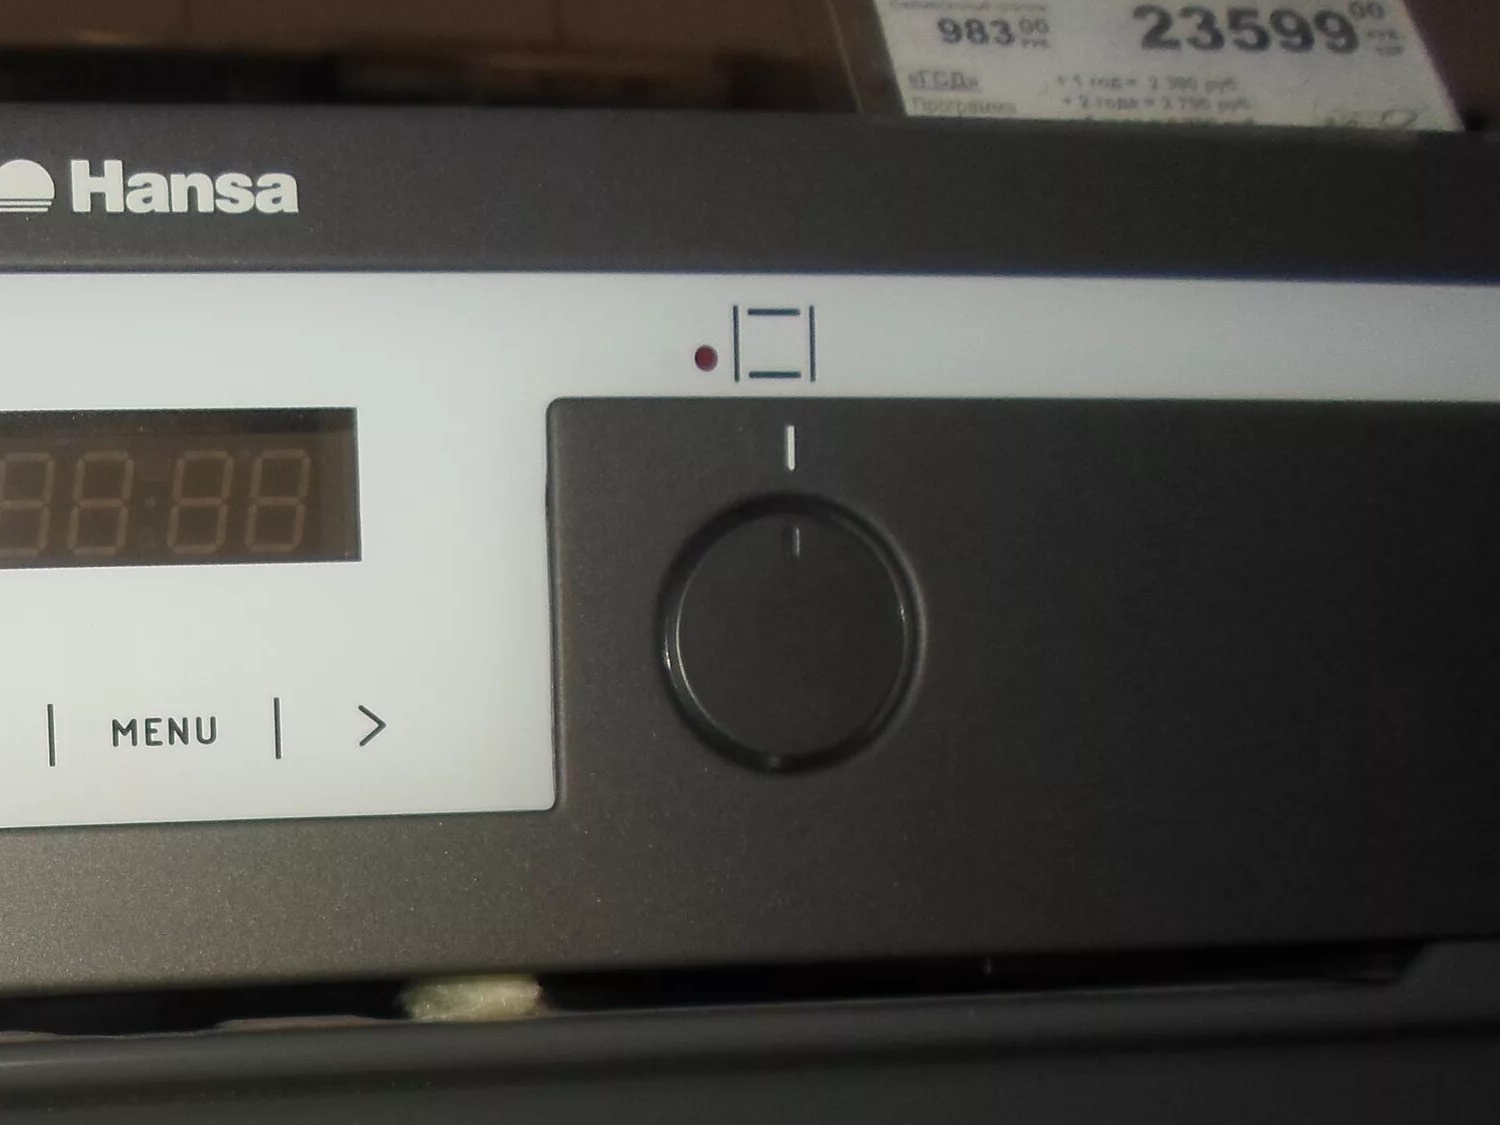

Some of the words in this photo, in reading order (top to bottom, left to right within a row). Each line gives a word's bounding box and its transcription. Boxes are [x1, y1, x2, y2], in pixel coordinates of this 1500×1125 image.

[937, 17, 1015, 45] 983
[1133, 5, 1358, 54] 23599
[71, 159, 299, 213] Hansa
[112, 715, 218, 748] MENU
